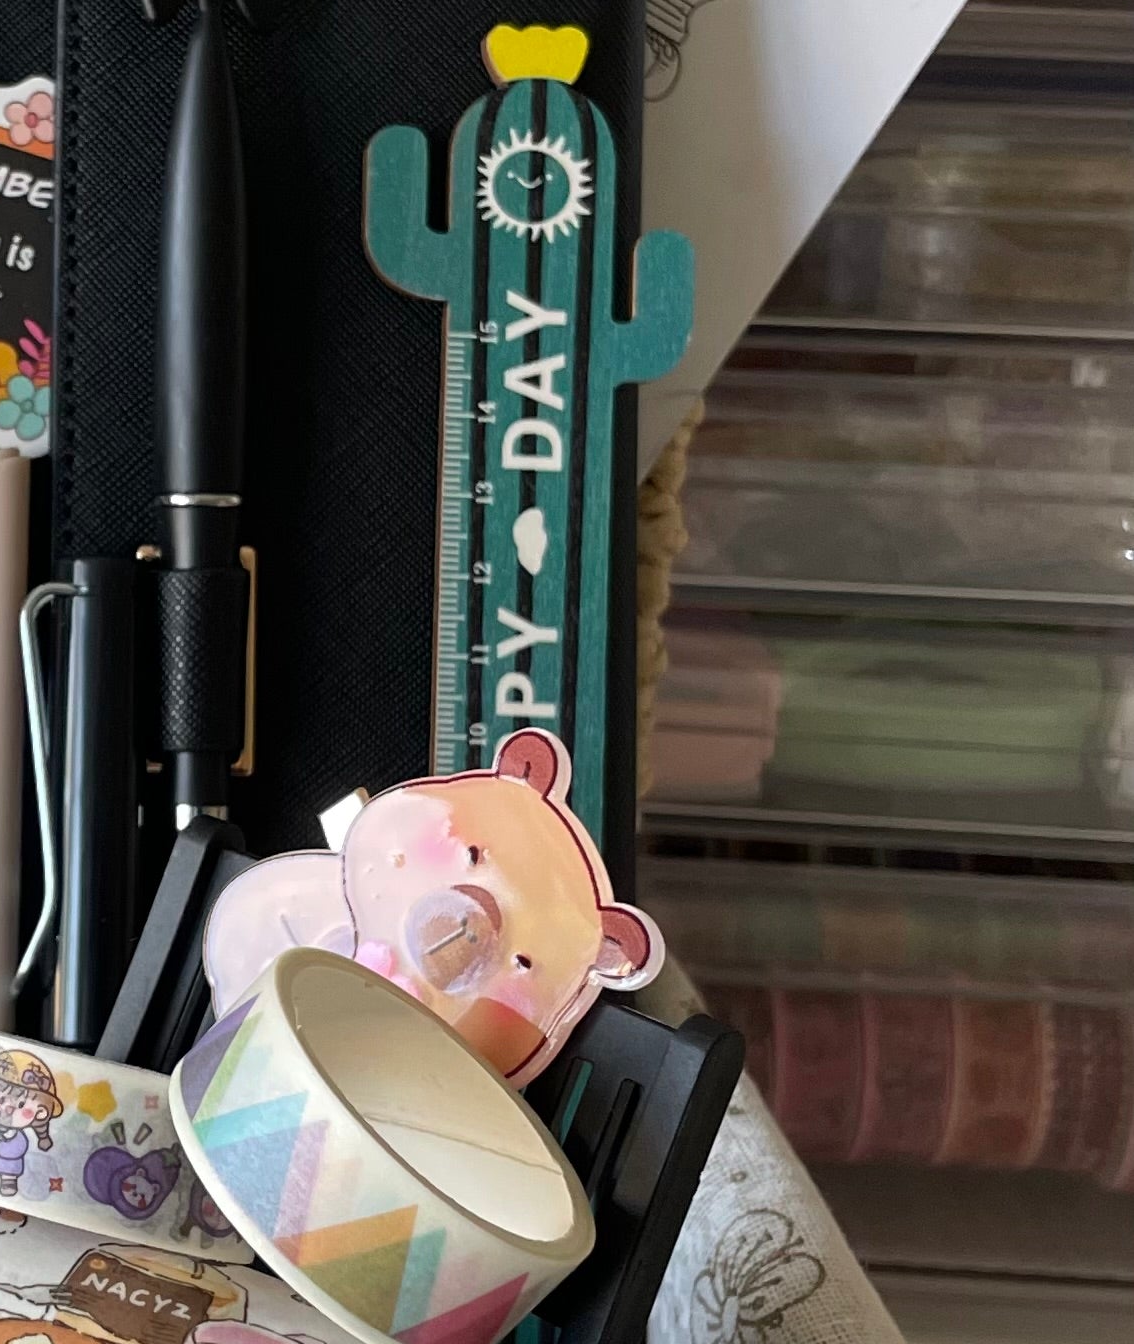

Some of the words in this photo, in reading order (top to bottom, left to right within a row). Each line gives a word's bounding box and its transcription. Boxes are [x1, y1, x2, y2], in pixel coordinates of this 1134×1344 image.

[5, 234, 36, 272] is
[479, 319, 500, 345] 15
[501, 290, 567, 473] DAY
[477, 399, 498, 425] 14
[474, 480, 496, 506] 13
[472, 560, 493, 587] 12
[471, 643, 491, 667] 11
[495, 607, 559, 748] PY
[468, 722, 489, 747] 10
